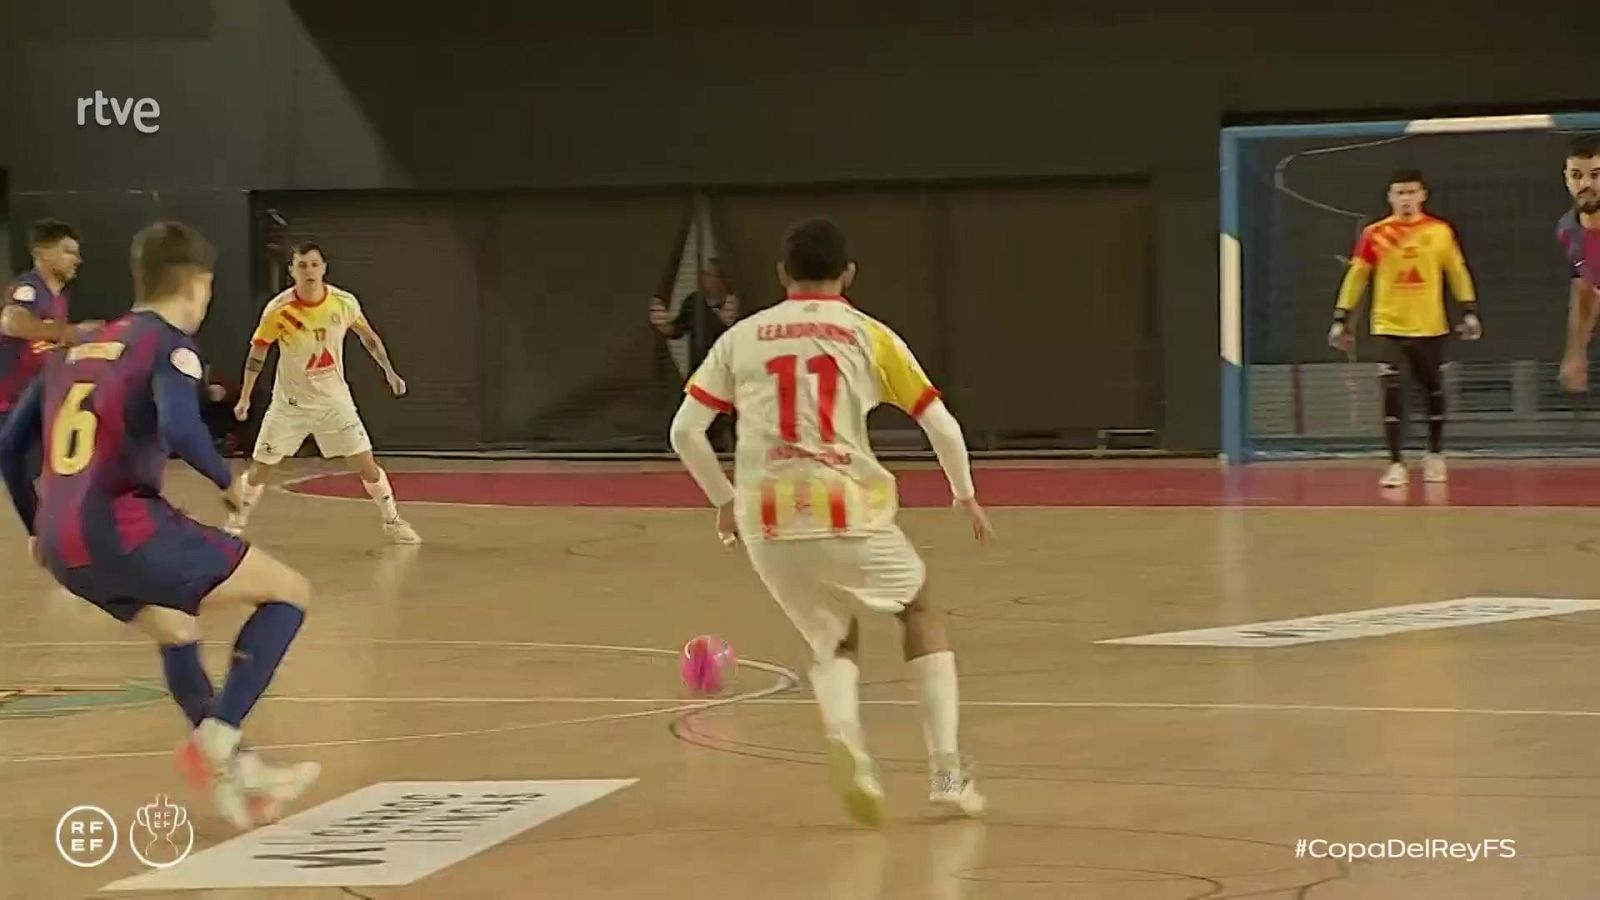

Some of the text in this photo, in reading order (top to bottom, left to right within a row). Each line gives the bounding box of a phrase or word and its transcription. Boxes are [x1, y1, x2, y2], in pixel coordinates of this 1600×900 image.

[312, 328, 326, 341] 17
[51, 382, 98, 475] 6
[765, 354, 838, 443] 11
